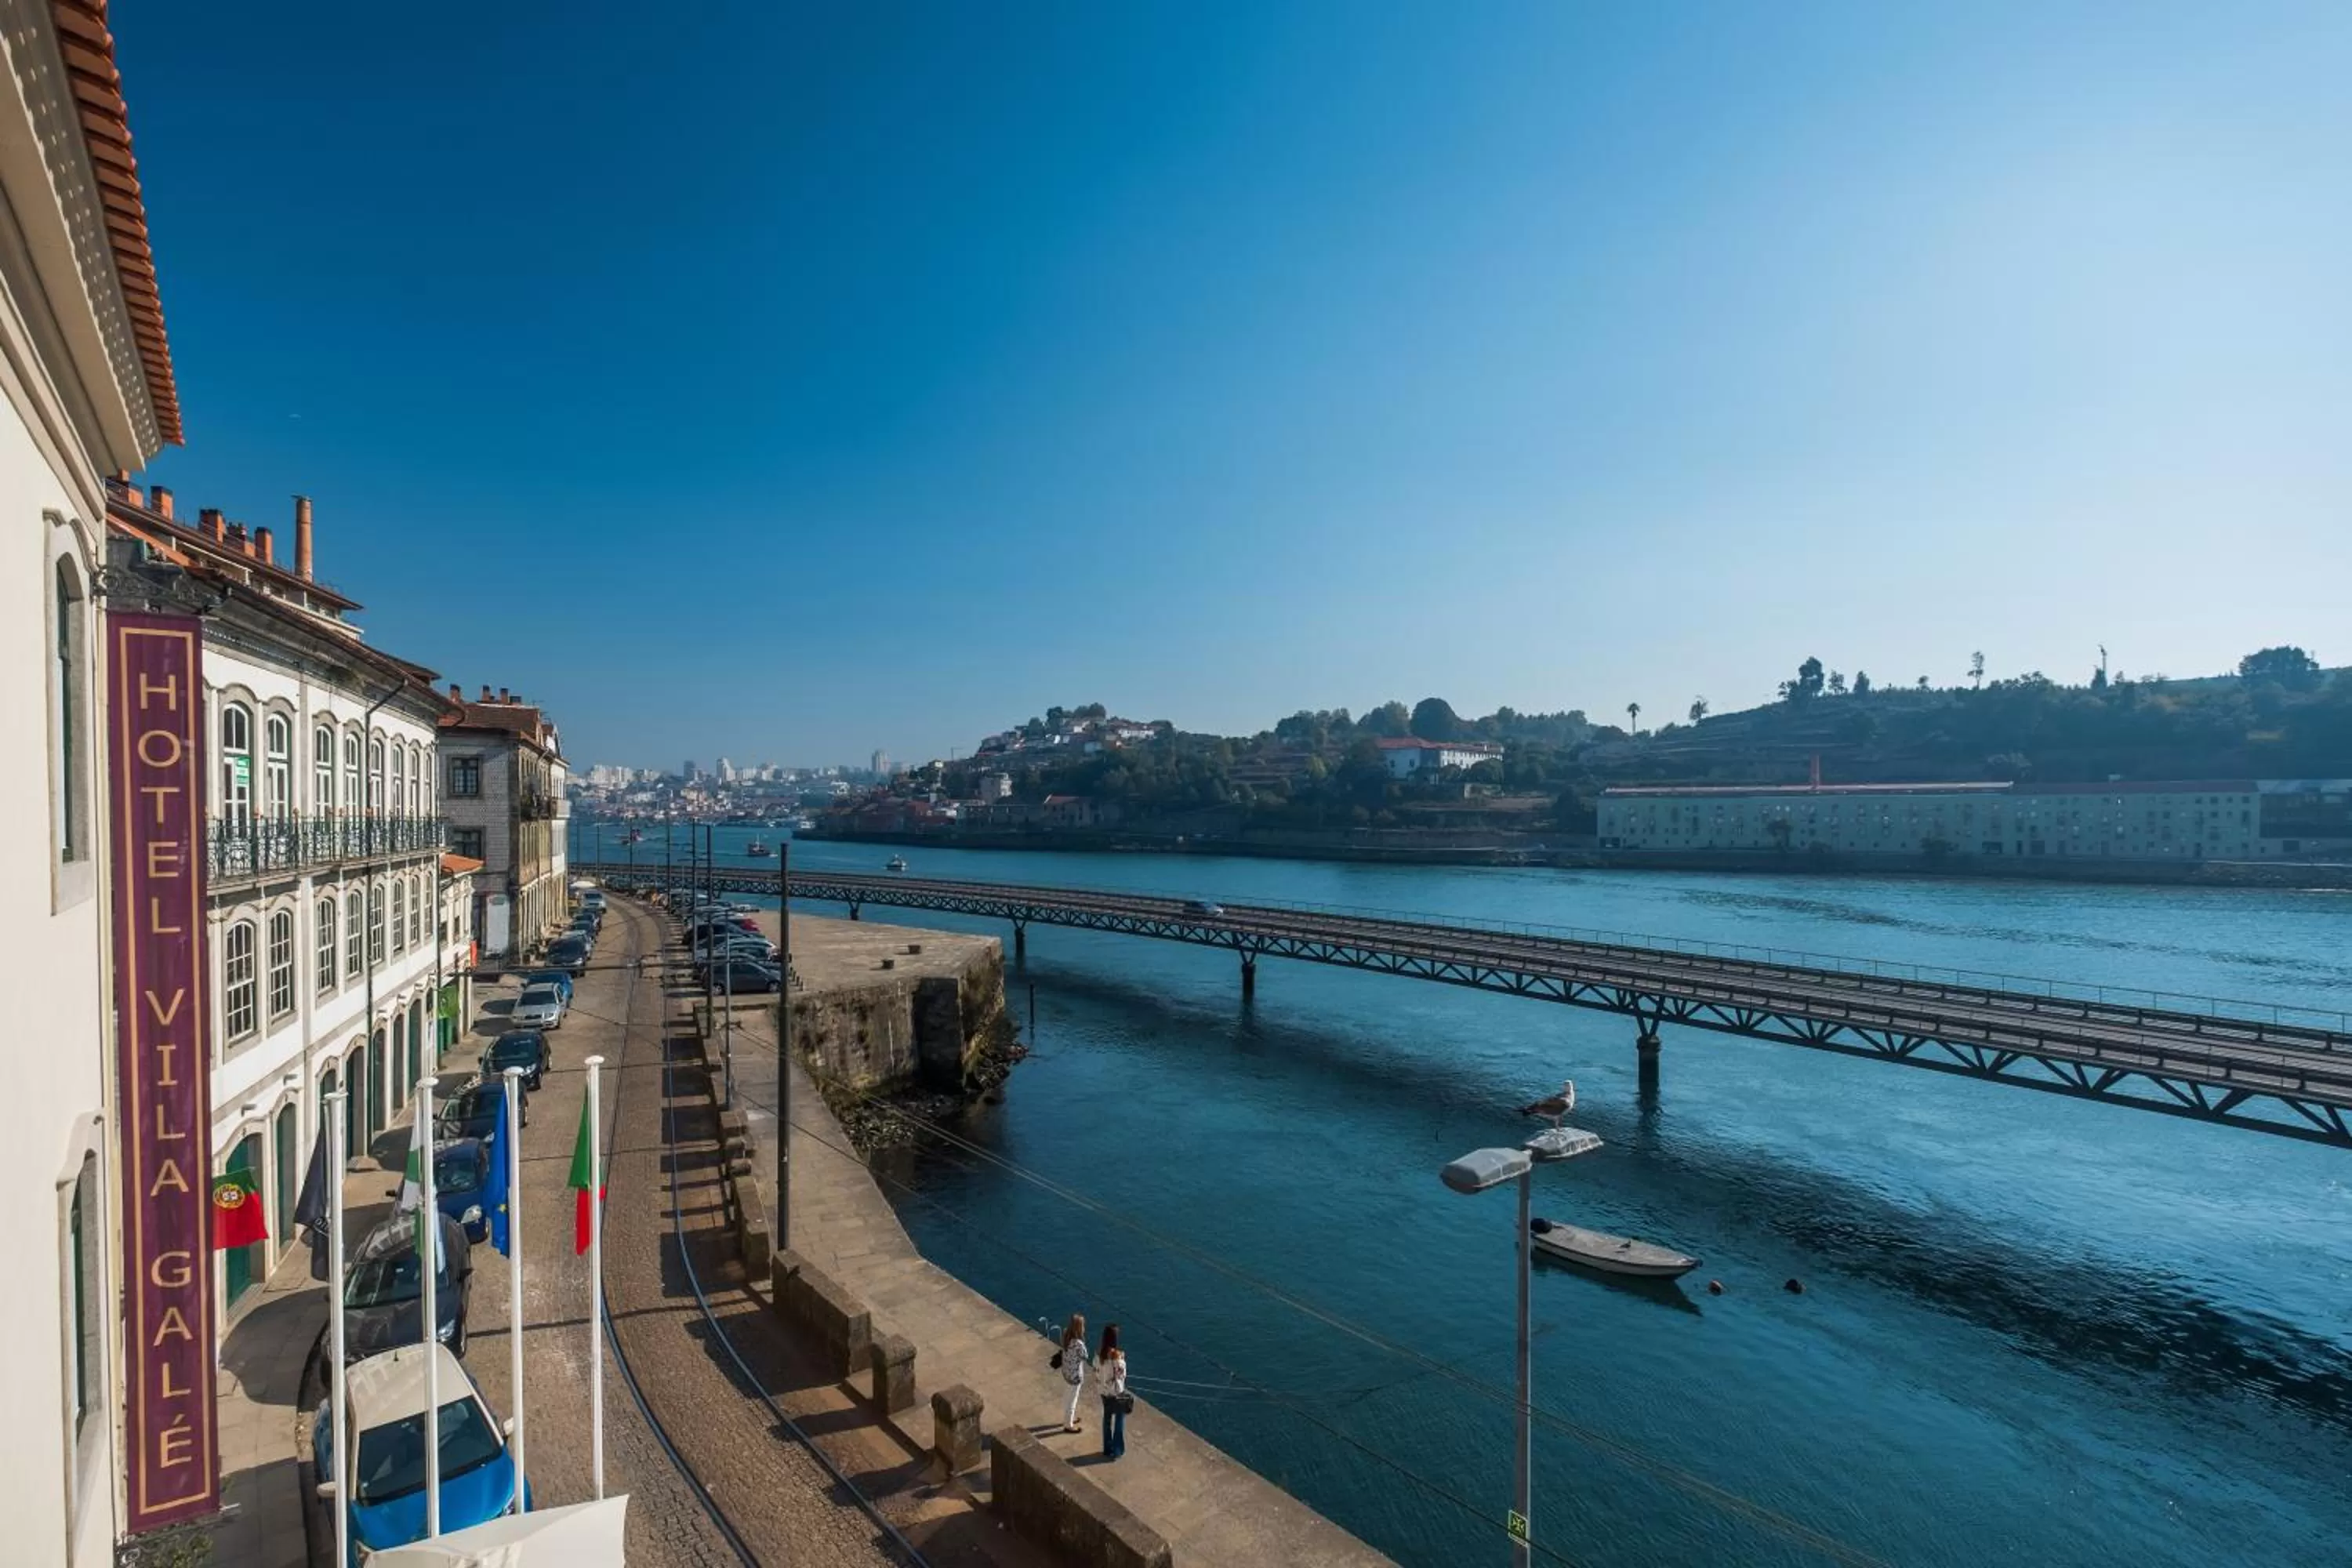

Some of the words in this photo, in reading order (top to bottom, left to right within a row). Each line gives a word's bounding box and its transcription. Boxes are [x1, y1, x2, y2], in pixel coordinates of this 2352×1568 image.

[138, 673, 182, 933] HOTEL
[145, 989, 189, 1196] VILA
[151, 1251, 192, 1468] GALÉ
